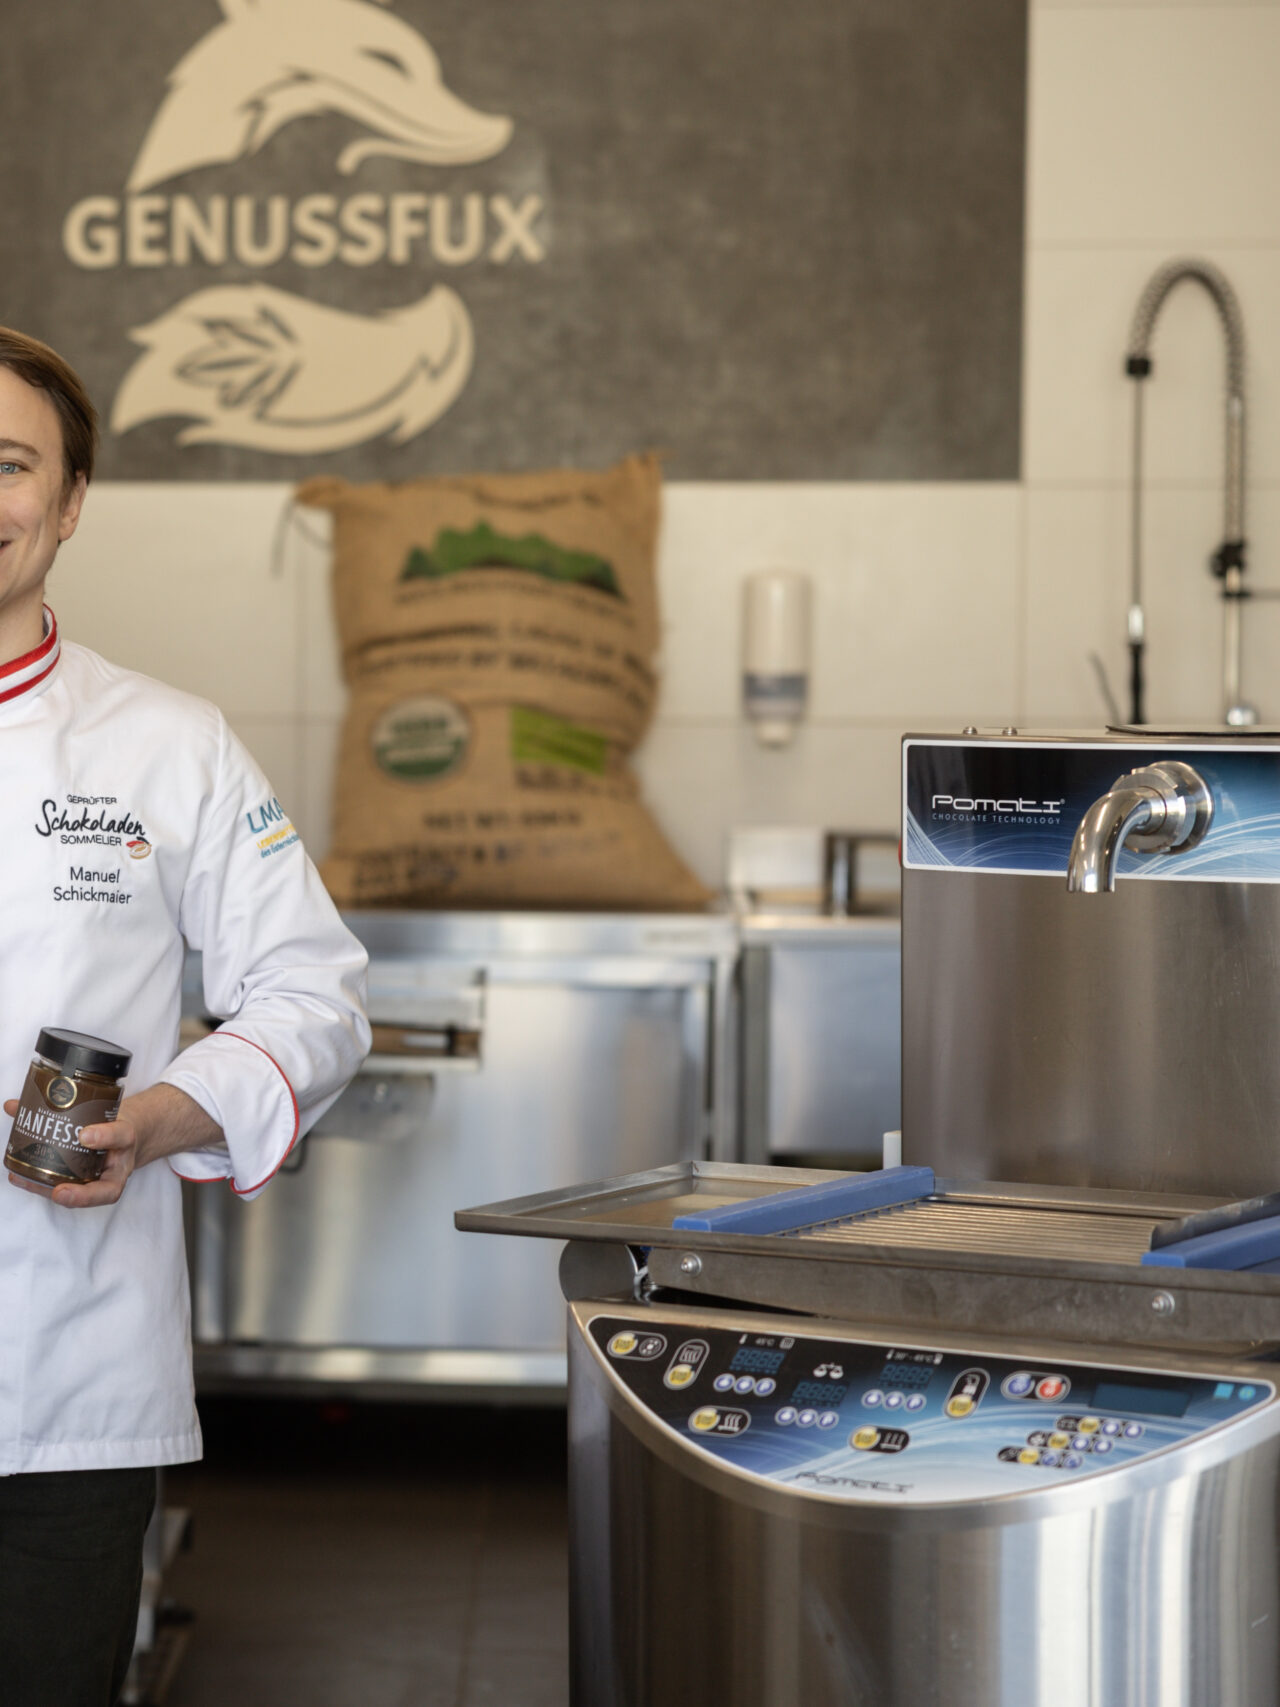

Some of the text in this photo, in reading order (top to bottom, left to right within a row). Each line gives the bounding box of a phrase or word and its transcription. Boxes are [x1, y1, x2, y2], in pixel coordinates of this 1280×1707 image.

[63, 194, 546, 269] GENUSSFUX
[66, 794, 118, 805] GEPRÜFTER
[35, 798, 146, 837] Schokoladen
[931, 812, 1061, 825] CHOCOLATE TECHNOLOGY
[59, 834, 122, 846] SOMMELIER
[69, 866, 121, 884] Manuel
[53, 885, 133, 905] Schickmaier
